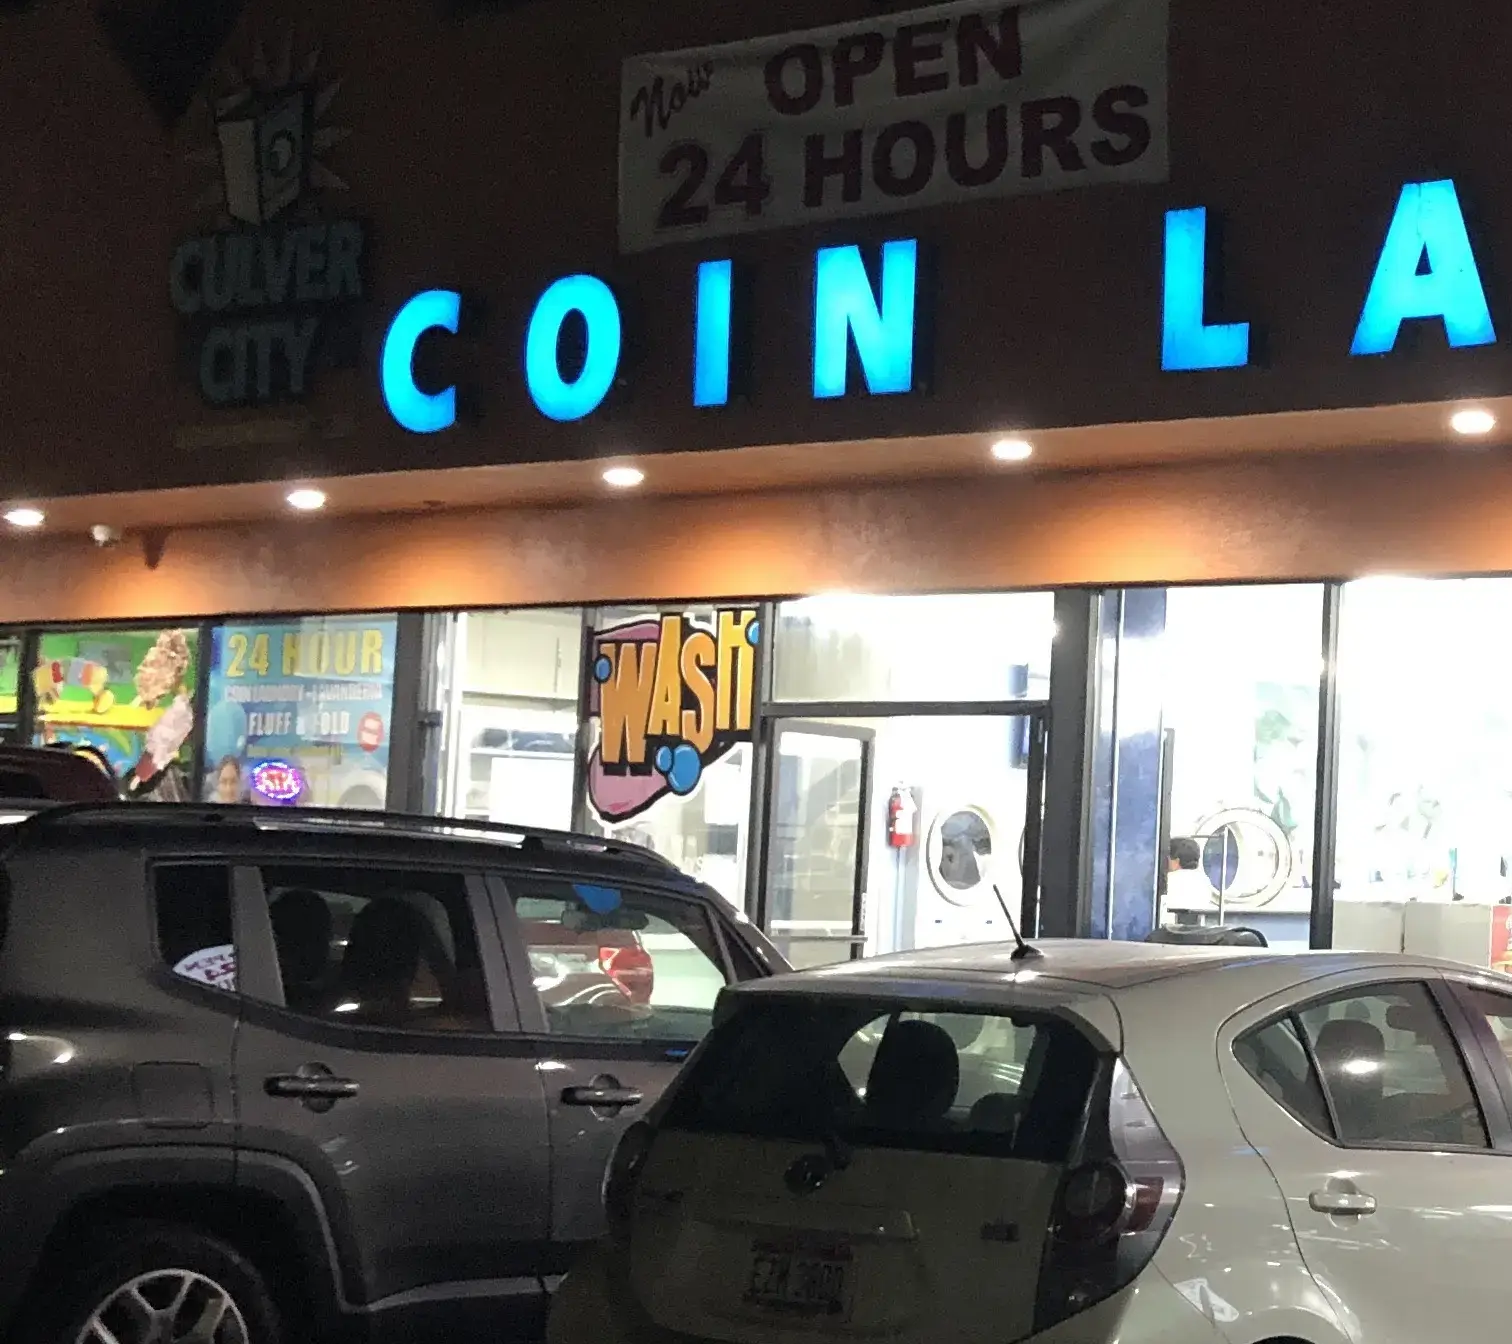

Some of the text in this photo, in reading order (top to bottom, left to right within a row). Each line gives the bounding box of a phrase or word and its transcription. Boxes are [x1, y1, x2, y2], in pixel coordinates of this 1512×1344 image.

[629, 60, 713, 137] Now
[763, 5, 1023, 115] OPEN
[655, 85, 1152, 229] 24 HOURS
[169, 220, 364, 313] CULVER
[199, 317, 318, 404] CITY
[381, 239, 917, 433] COIN
[226, 629, 383, 677] 24 HOUR
[600, 610, 756, 763] WASH
[249, 712, 291, 736] FLUFF
